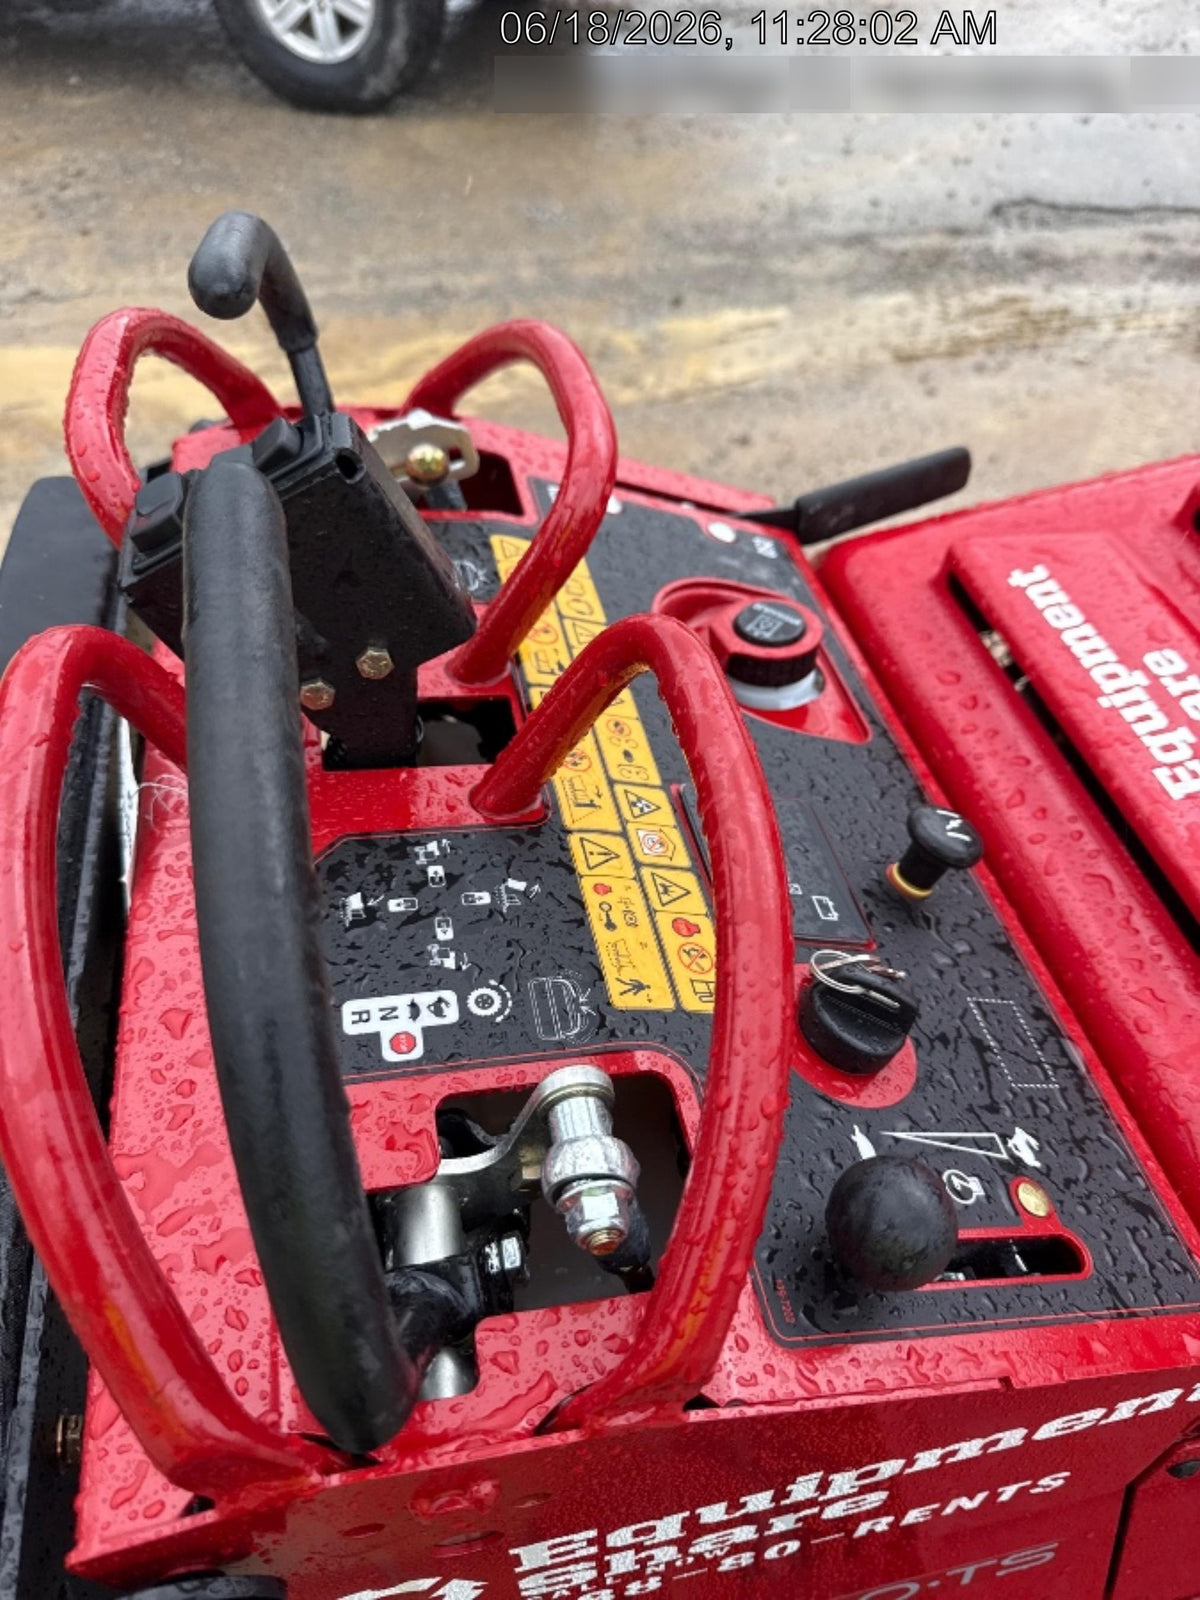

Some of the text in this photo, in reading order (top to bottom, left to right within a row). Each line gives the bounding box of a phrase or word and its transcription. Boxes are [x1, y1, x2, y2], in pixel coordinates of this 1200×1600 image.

[1007, 564, 1200, 800] Equipment
[351, 1009, 371, 1025] R
[378, 1005, 399, 1021] N
[518, 1491, 889, 1597] Share
[526, 1575, 621, 1600] ALL
